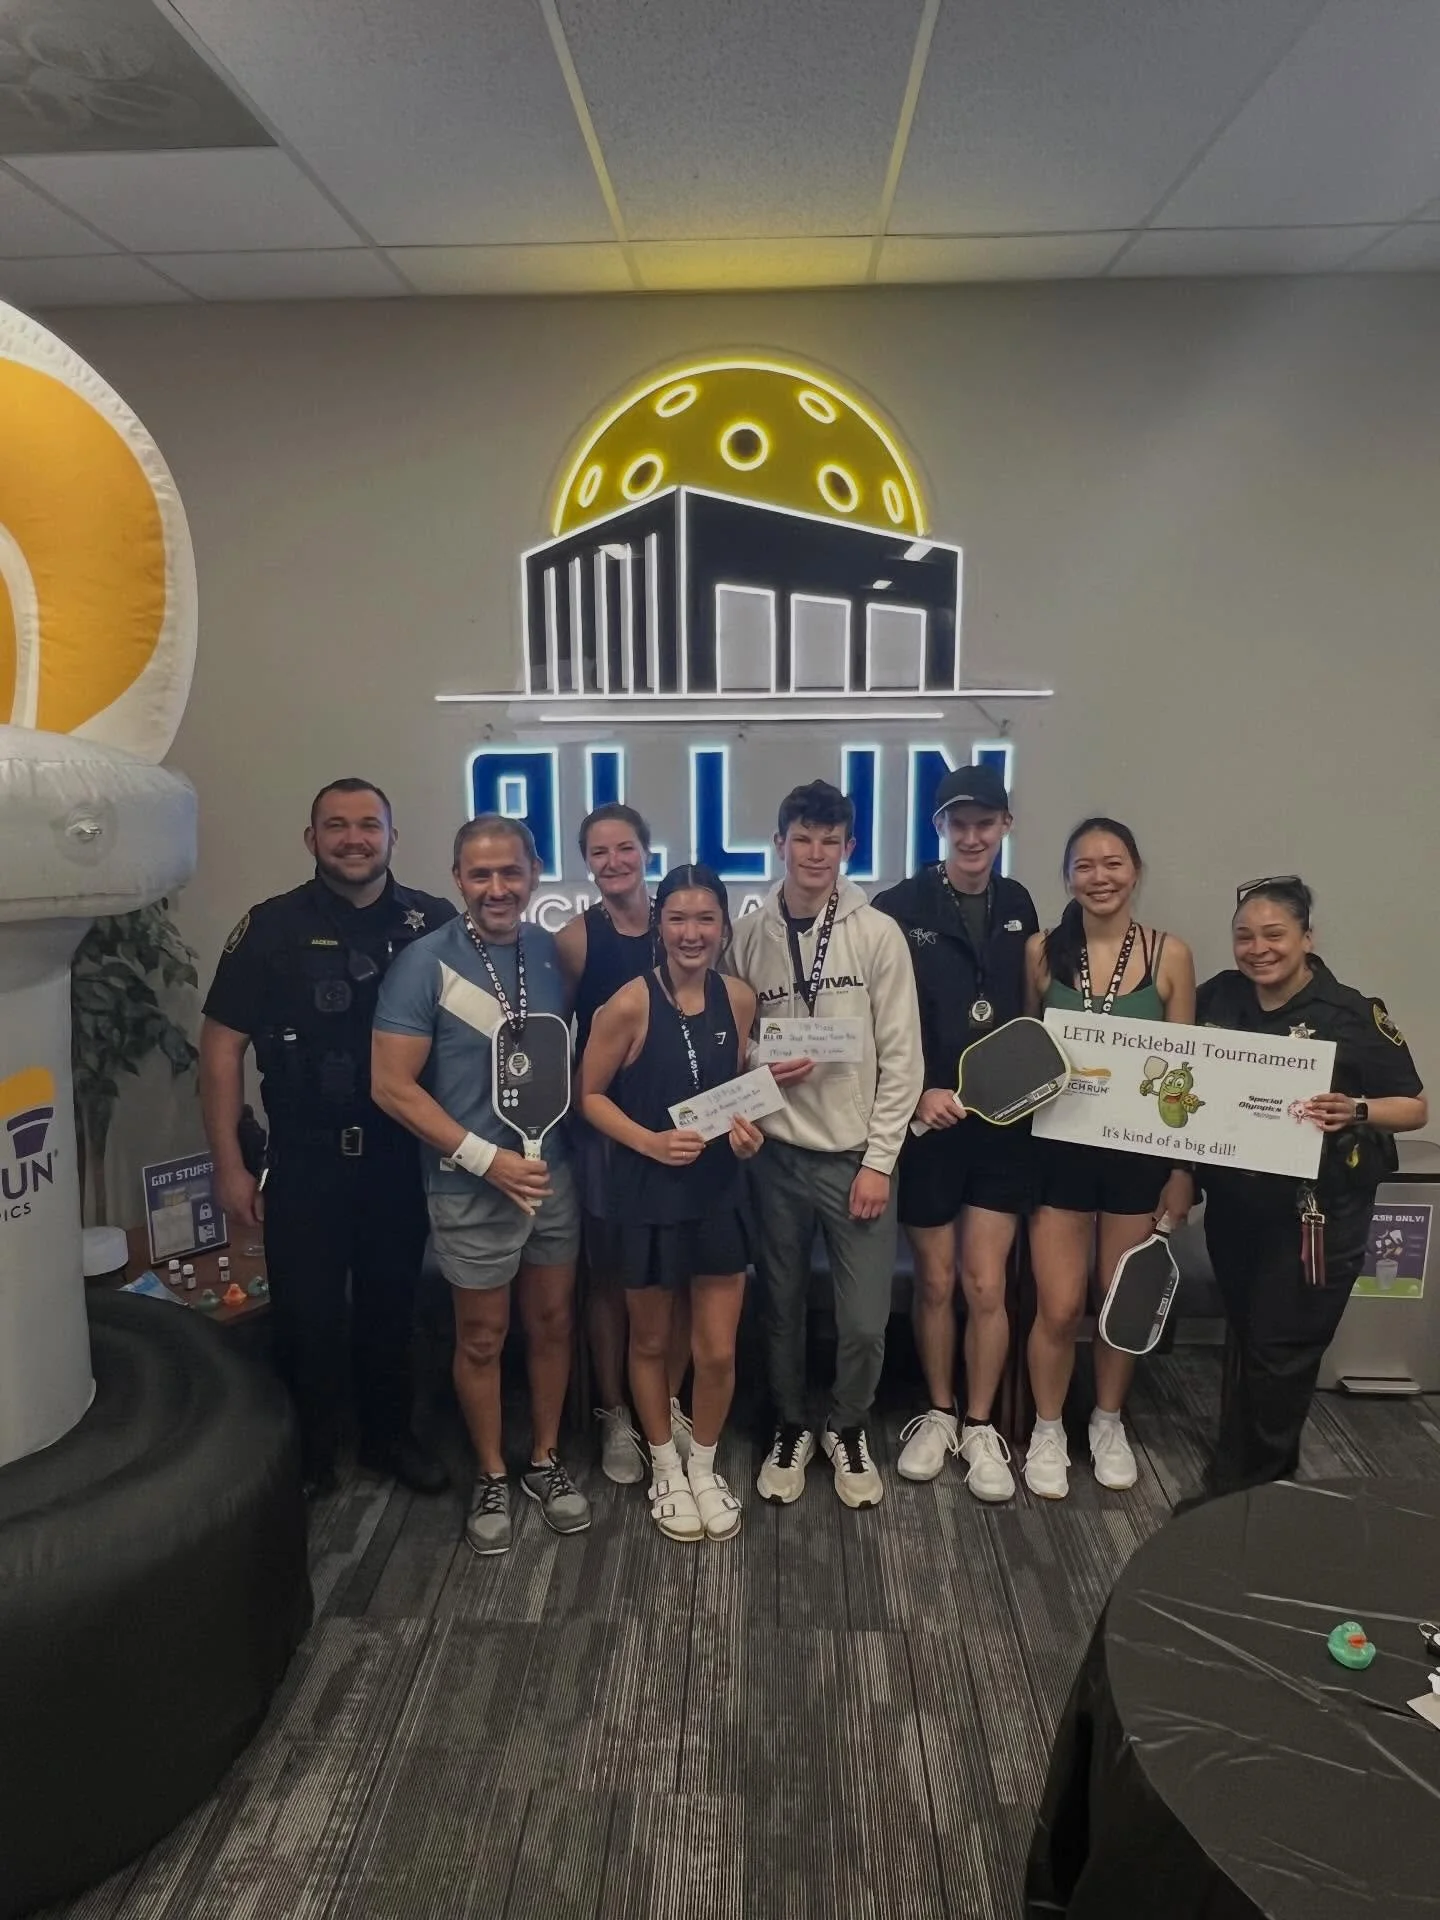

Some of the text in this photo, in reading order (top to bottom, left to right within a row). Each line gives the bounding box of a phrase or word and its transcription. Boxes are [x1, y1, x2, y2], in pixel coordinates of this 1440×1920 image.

[840, 744, 1013, 881] IN
[810, 937, 828, 992] PLACE
[486, 963, 514, 1020] SECOND
[519, 966, 527, 1018] PLACE
[1081, 970, 1093, 1013] THIR
[1102, 975, 1121, 1015] PLAC
[684, 1030, 698, 1079] FIRST
[1063, 1026, 1316, 1070] LETR Pickleball Tournament
[1087, 1084, 1108, 1094] RUN
[1248, 1095, 1283, 1105] Special
[1102, 1126, 1237, 1156] It's kind of a big dill!
[0, 1153, 54, 1200] UN
[151, 1162, 214, 1187] GOT STUFF?
[1371, 1214, 1425, 1223] ASH ONLY!
